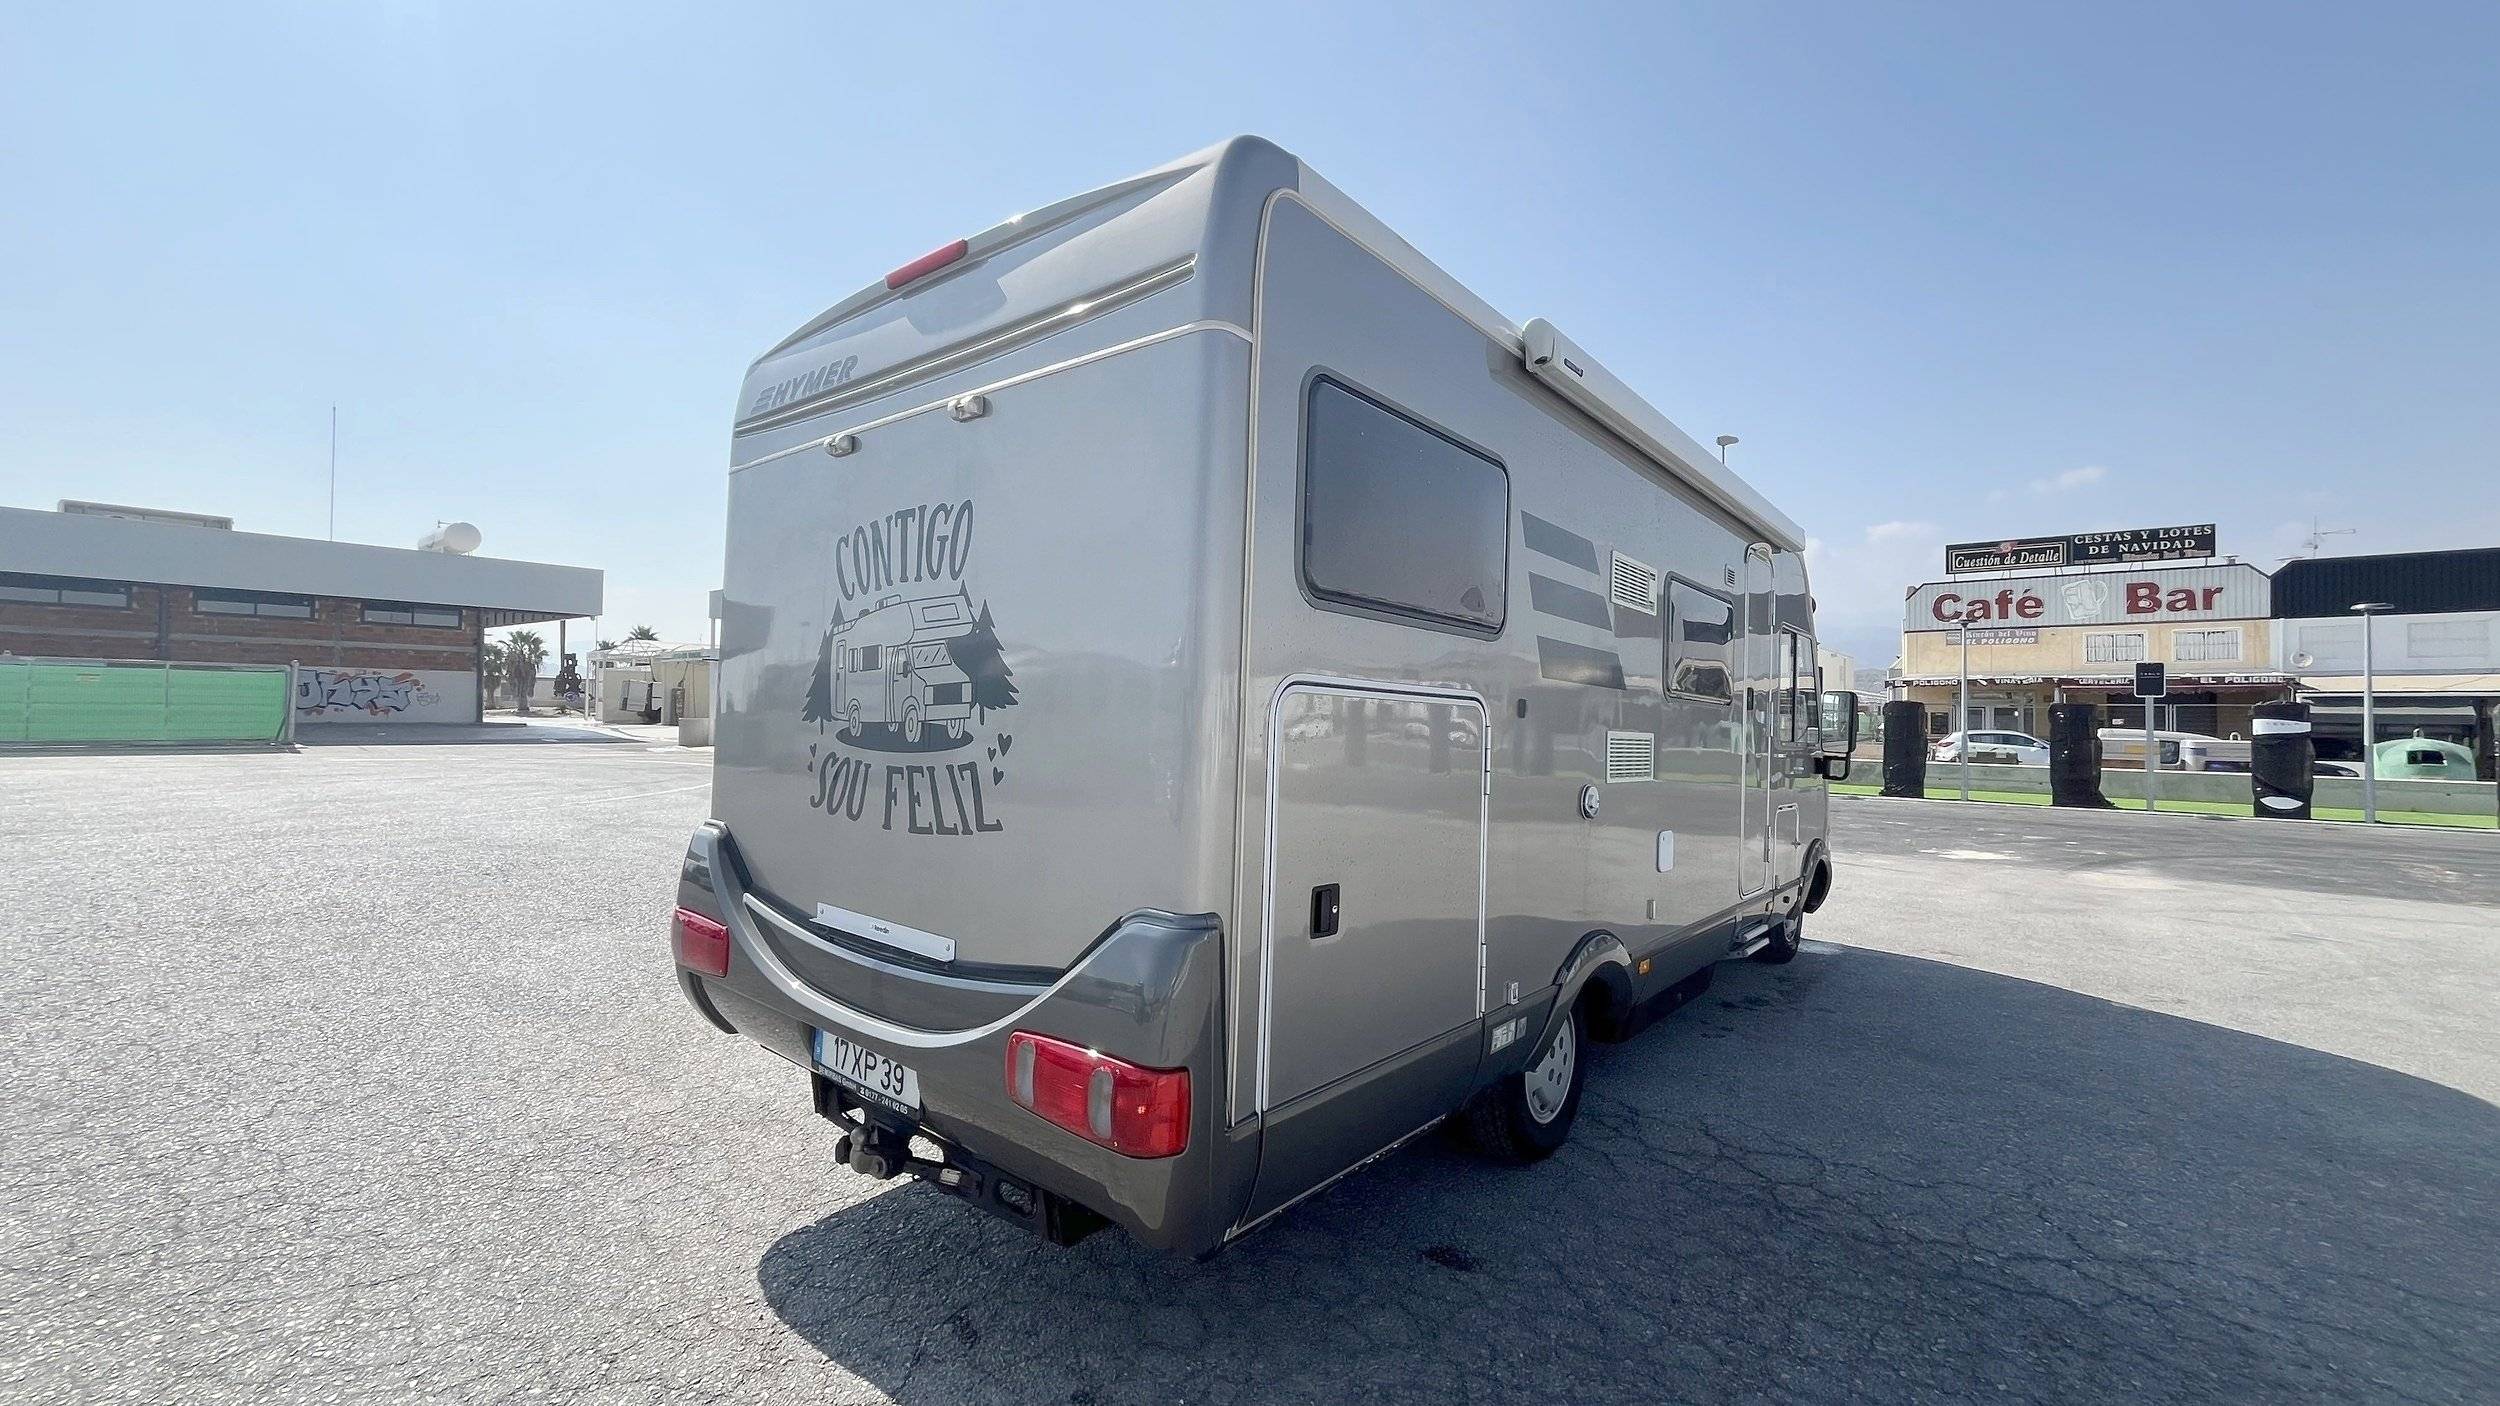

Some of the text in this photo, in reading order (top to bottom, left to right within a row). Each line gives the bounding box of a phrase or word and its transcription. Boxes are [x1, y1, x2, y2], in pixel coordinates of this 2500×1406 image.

[771, 355, 859, 408] HYMER
[836, 500, 974, 600] CONTIGO
[2074, 525, 2212, 545] CESTAS Y LOTES
[2088, 539, 2196, 555] DE NAVIDAD
[1955, 552, 2001, 569] Cuestión
[2003, 551, 2017, 566] de
[2019, 549, 2060, 565] Detalle
[1932, 581, 2224, 623] Café Bar
[810, 751, 1003, 836] SOU FELIZ
